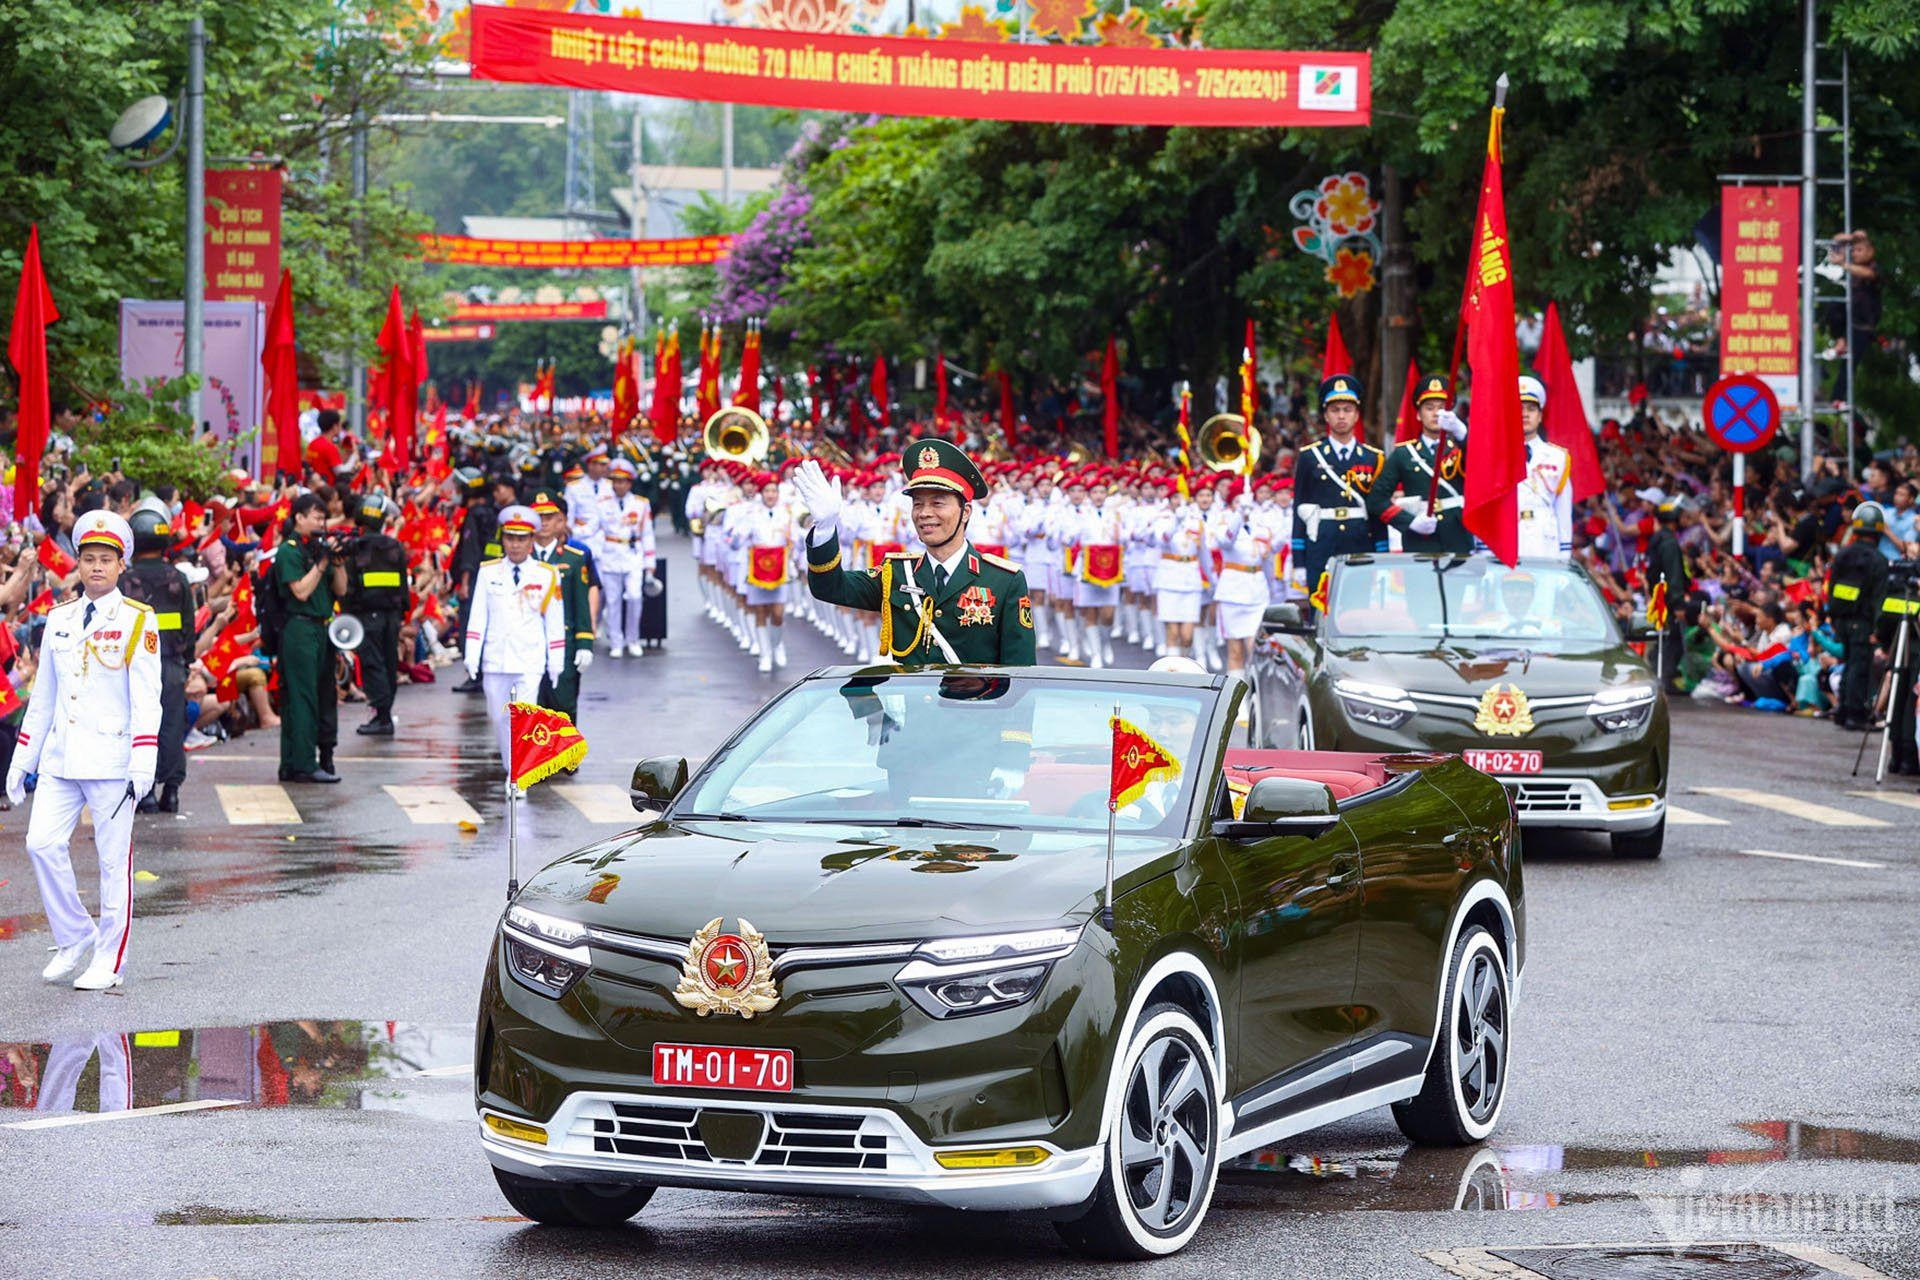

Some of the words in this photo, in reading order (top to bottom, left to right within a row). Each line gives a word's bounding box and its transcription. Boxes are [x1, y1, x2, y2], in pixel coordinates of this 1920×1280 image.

[550, 26, 605, 66] NHIỆT
[608, 30, 646, 70] LIỆT
[650, 34, 699, 72] CHÀO
[704, 38, 759, 76] MỪNG
[762, 47, 786, 79] 70
[790, 43, 833, 82] NĂM
[837, 47, 893, 86] CHIẾN
[961, 54, 1005, 95] ĐIỆN
[1008, 57, 1052, 93] BIÊN
[1055, 57, 1093, 95] PHỦ
[1096, 65, 1180, 97] (7/5/1954
[1196, 67, 1287, 102] 7/5/2024)!
[1466, 752, 1540, 772] TM-02-70
[659, 1048, 788, 1087] TM-01-70
